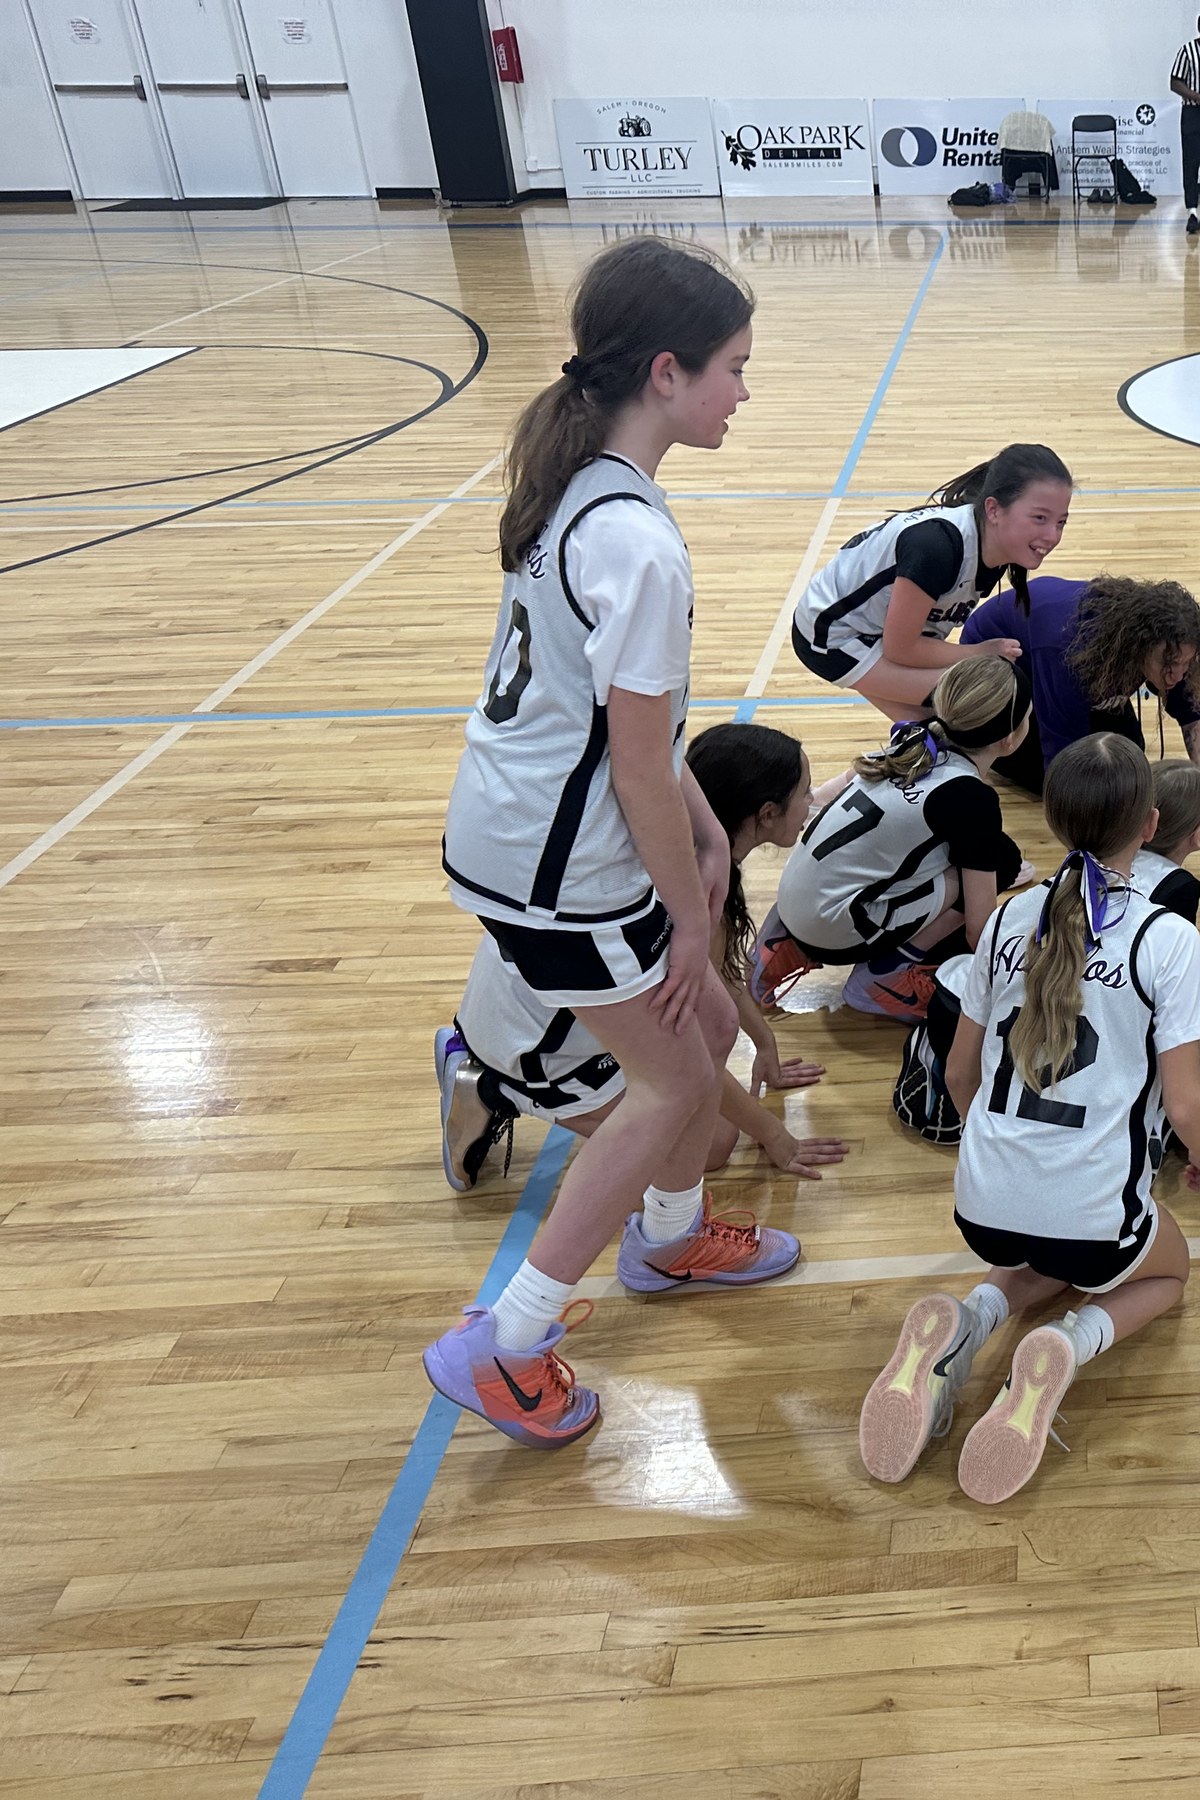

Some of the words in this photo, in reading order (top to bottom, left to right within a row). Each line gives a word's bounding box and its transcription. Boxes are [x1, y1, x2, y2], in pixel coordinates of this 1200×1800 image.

[597, 101, 621, 115] SALEM
[632, 100, 666, 114] OREGON
[736, 124, 795, 151] OAK
[799, 125, 866, 150] PARK
[941, 127, 999, 146] Unite
[583, 147, 692, 171] TURLEY
[764, 149, 839, 158] DENTAL
[1126, 145, 1171, 156] Strategies
[630, 173, 652, 182] LLC
[801, 782, 885, 862] 17
[988, 1006, 1100, 1129] 12
